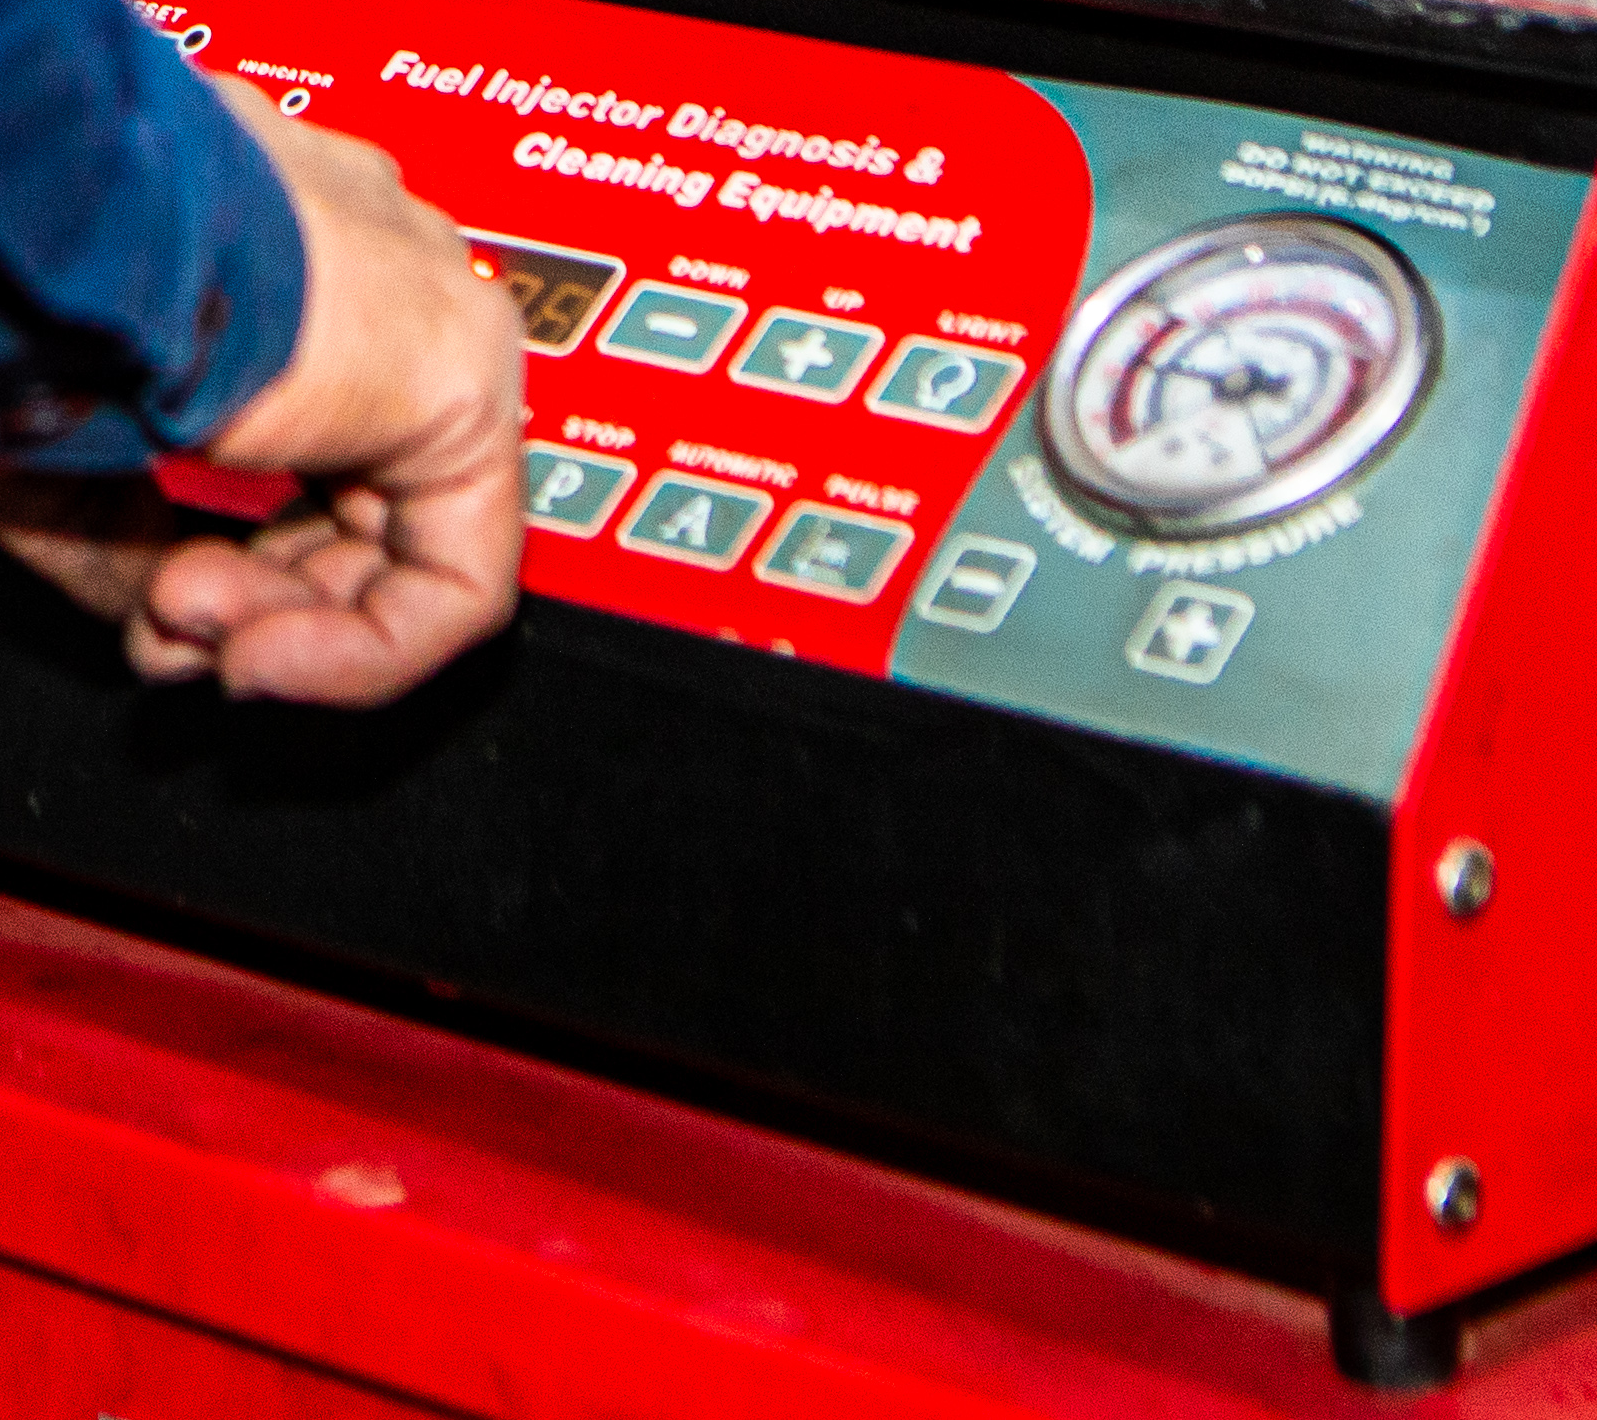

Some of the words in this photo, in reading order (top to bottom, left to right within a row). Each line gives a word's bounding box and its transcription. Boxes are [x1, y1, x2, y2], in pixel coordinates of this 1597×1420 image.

[132, 0, 188, 23] ESET
[237, 58, 335, 89] INDICATOR
[380, 49, 485, 96] Fuel
[481, 67, 665, 130] Injector
[666, 102, 901, 176] Diagnosis
[903, 146, 946, 185] &
[512, 131, 716, 208] Cleaning
[716, 170, 982, 254] Equipment
[667, 254, 751, 290] DOWN
[821, 285, 866, 312] UP
[936, 308, 1029, 347] LIGHT
[561, 414, 637, 450] STOP
[665, 439, 799, 489] AUTOMATIC
[531, 461, 585, 513] P
[822, 472, 921, 517] PULSE
[659, 493, 712, 547] A
